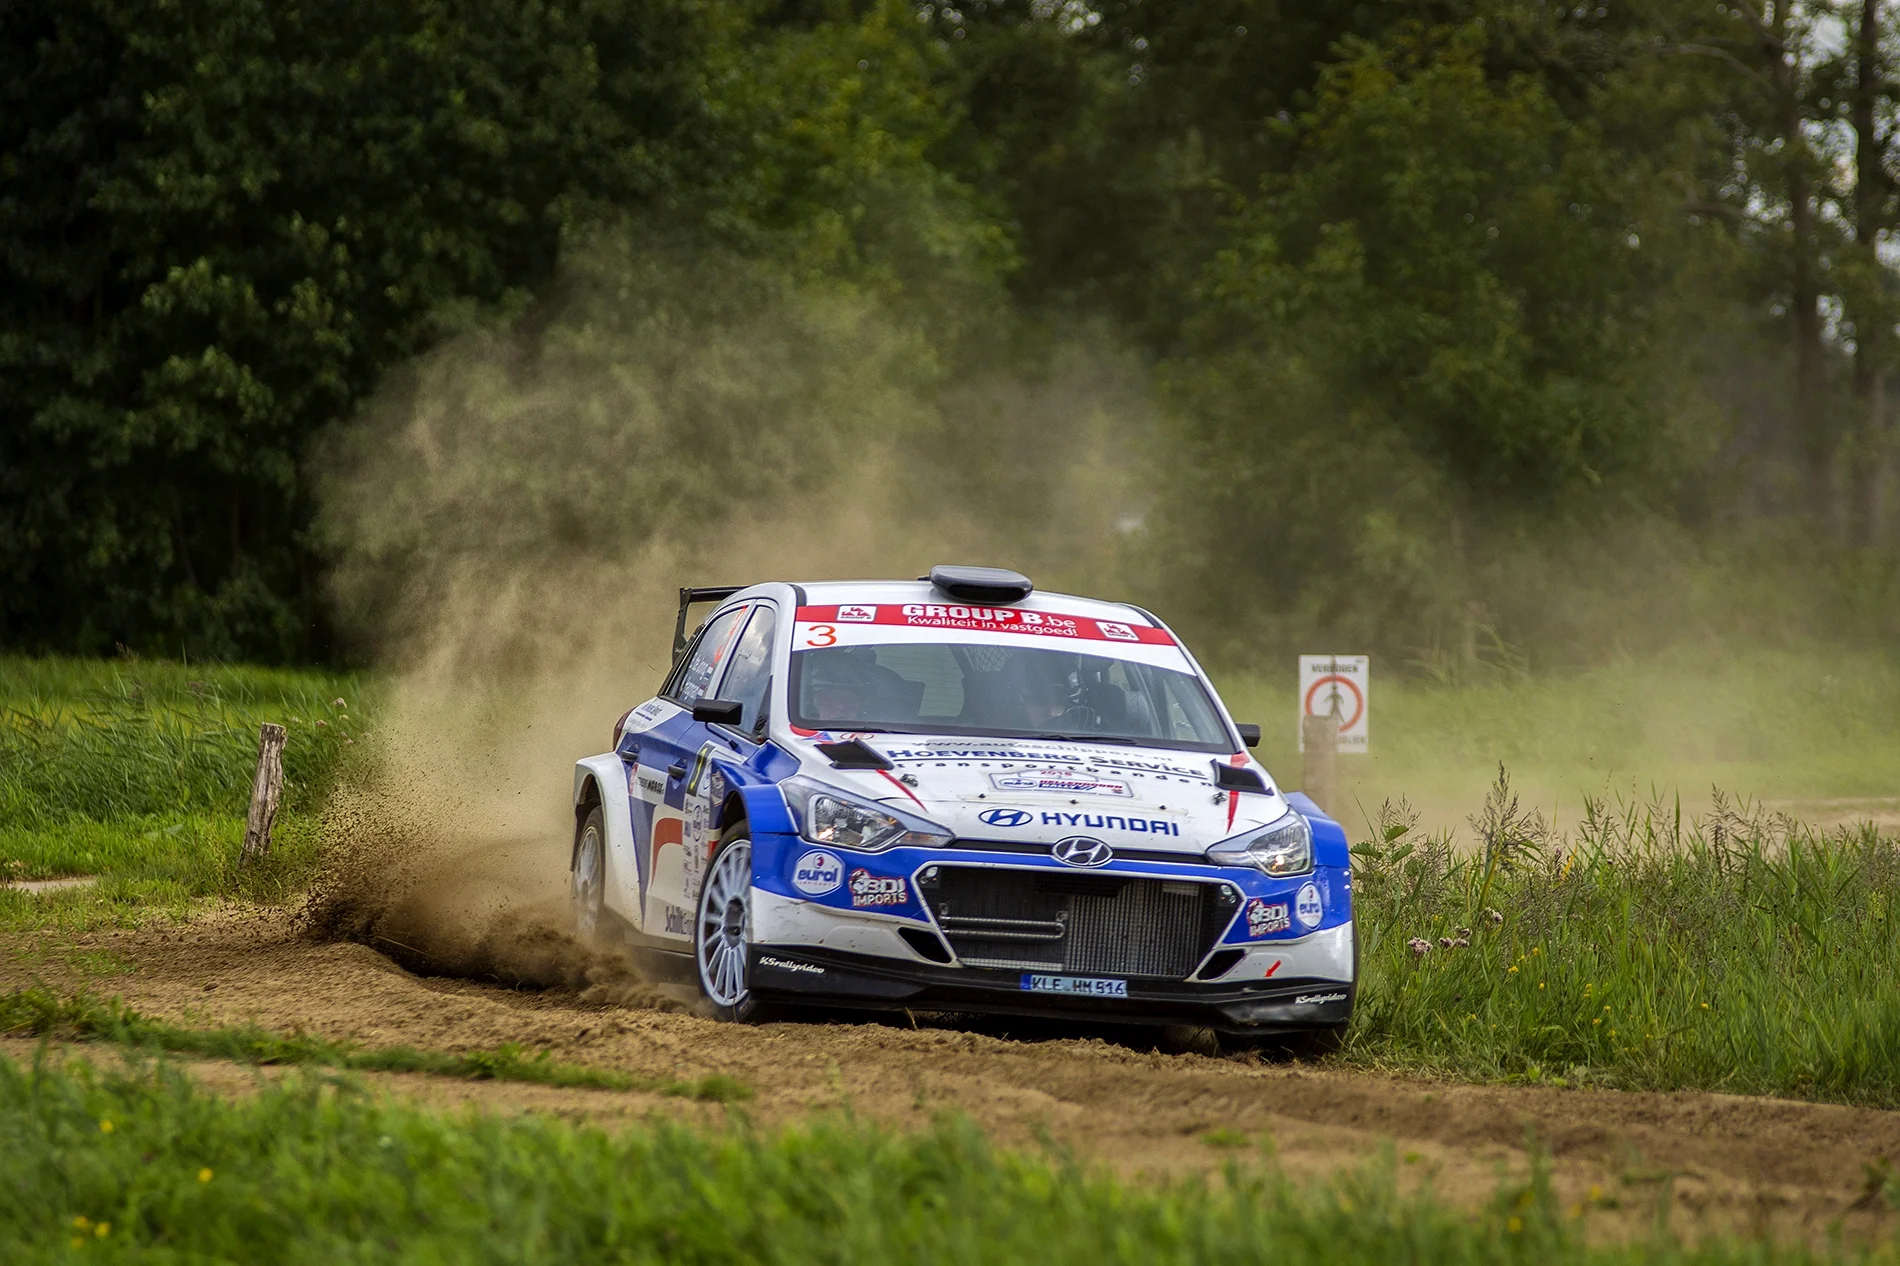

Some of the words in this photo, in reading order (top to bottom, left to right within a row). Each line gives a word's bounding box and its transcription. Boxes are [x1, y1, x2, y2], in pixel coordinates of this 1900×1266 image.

[902, 604, 1015, 622] GROUP
[806, 625, 837, 647] 3
[907, 616, 978, 629] Kwaliteit
[982, 620, 997, 629] in
[1001, 622, 1079, 637] vastgoed!
[887, 750, 1081, 761] HOEVENBERG
[1041, 812, 1180, 836] HYUNDAI
[797, 867, 838, 883] eurol
[853, 892, 908, 907] IMPORTS
[1249, 917, 1291, 937] IMPORTS
[759, 956, 825, 975] KSrallyvideo
[1032, 976, 1062, 991] KLE
[1073, 979, 1092, 993] HM
[1096, 981, 1126, 995] 516
